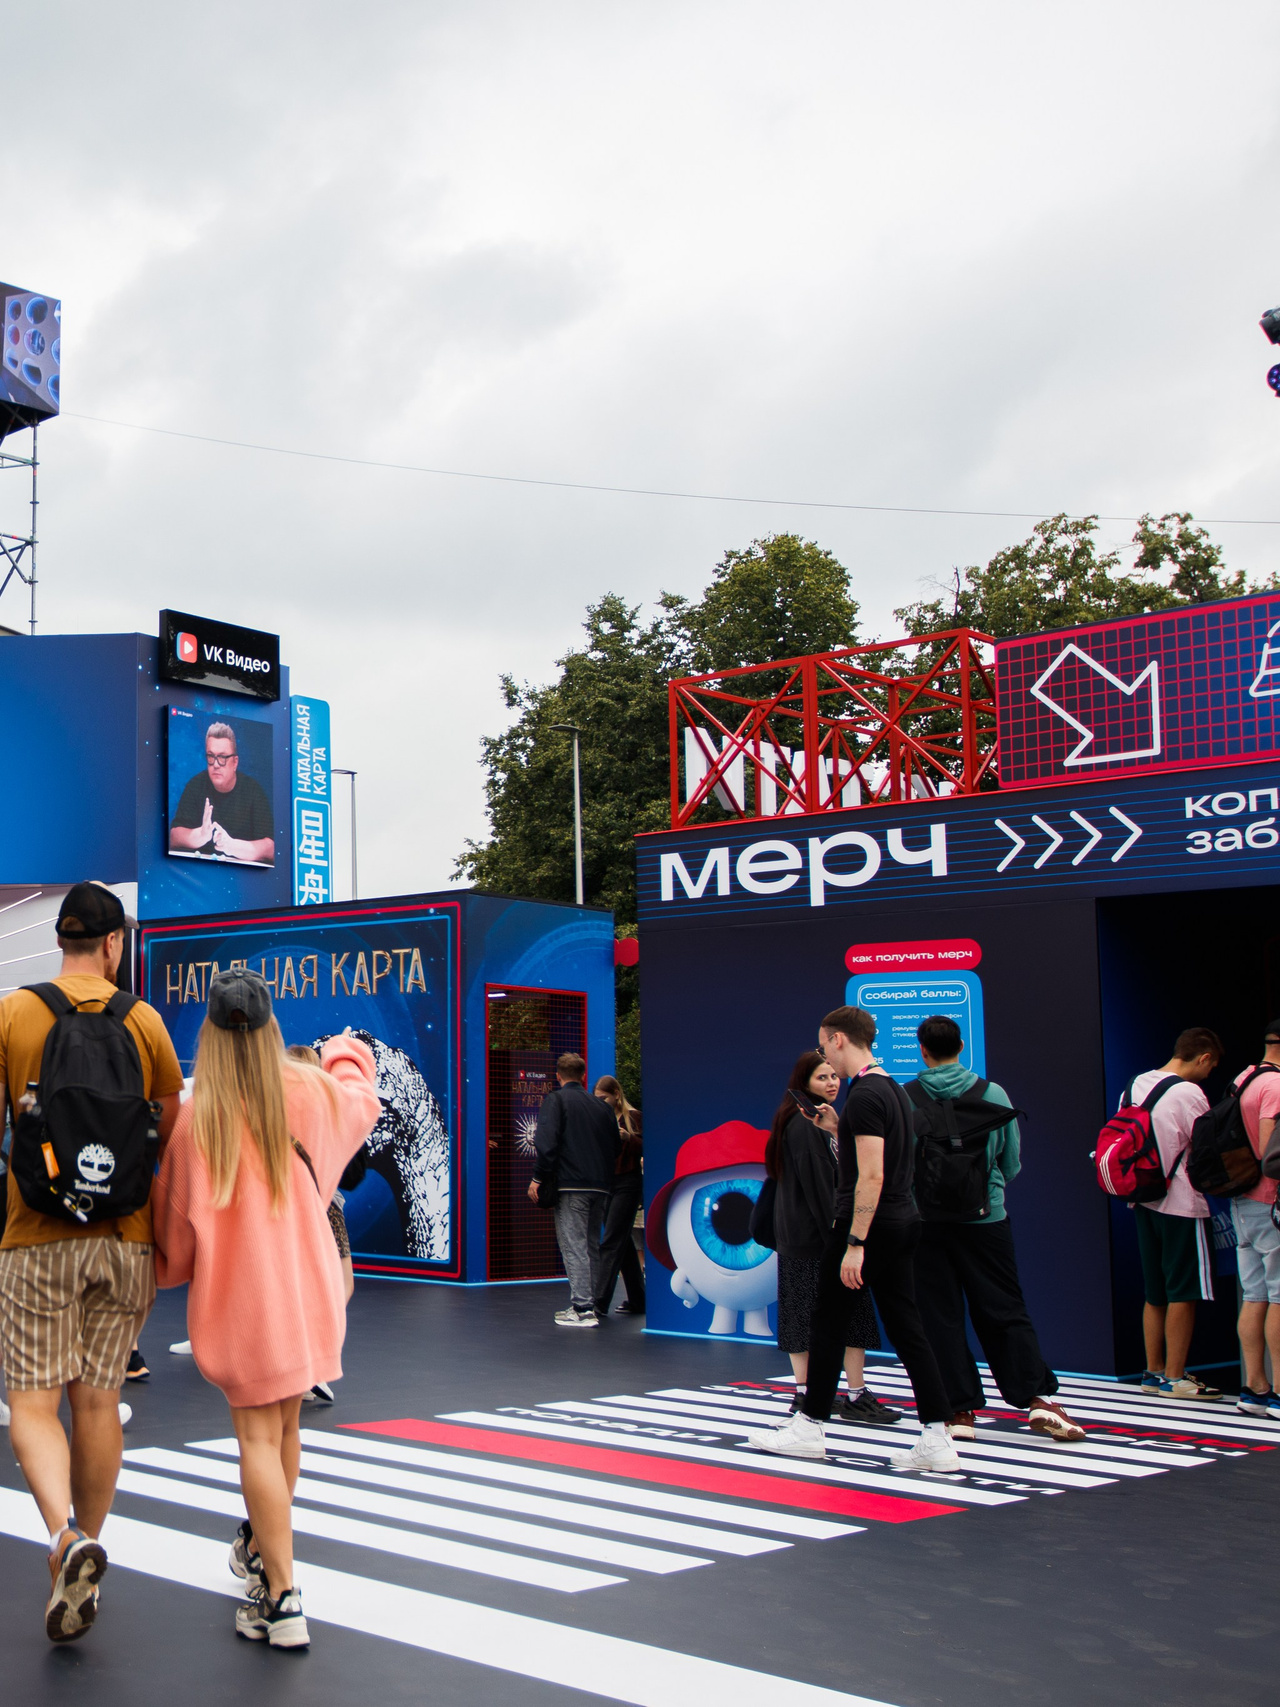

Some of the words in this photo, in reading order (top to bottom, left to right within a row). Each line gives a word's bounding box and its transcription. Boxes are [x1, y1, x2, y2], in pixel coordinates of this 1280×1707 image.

[203, 643, 224, 664] VK
[226, 649, 271, 674] Видео
[297, 703, 311, 793] НАТАЛЬНАЯ
[312, 746, 328, 796] КАРТА
[660, 823, 948, 907] мерч
[331, 947, 428, 997] КАРТА
[852, 954, 873, 963] как
[875, 952, 935, 963] получить
[937, 950, 973, 960] мерч
[865, 989, 918, 1001] собирай
[920, 989, 962, 998] баллы:
